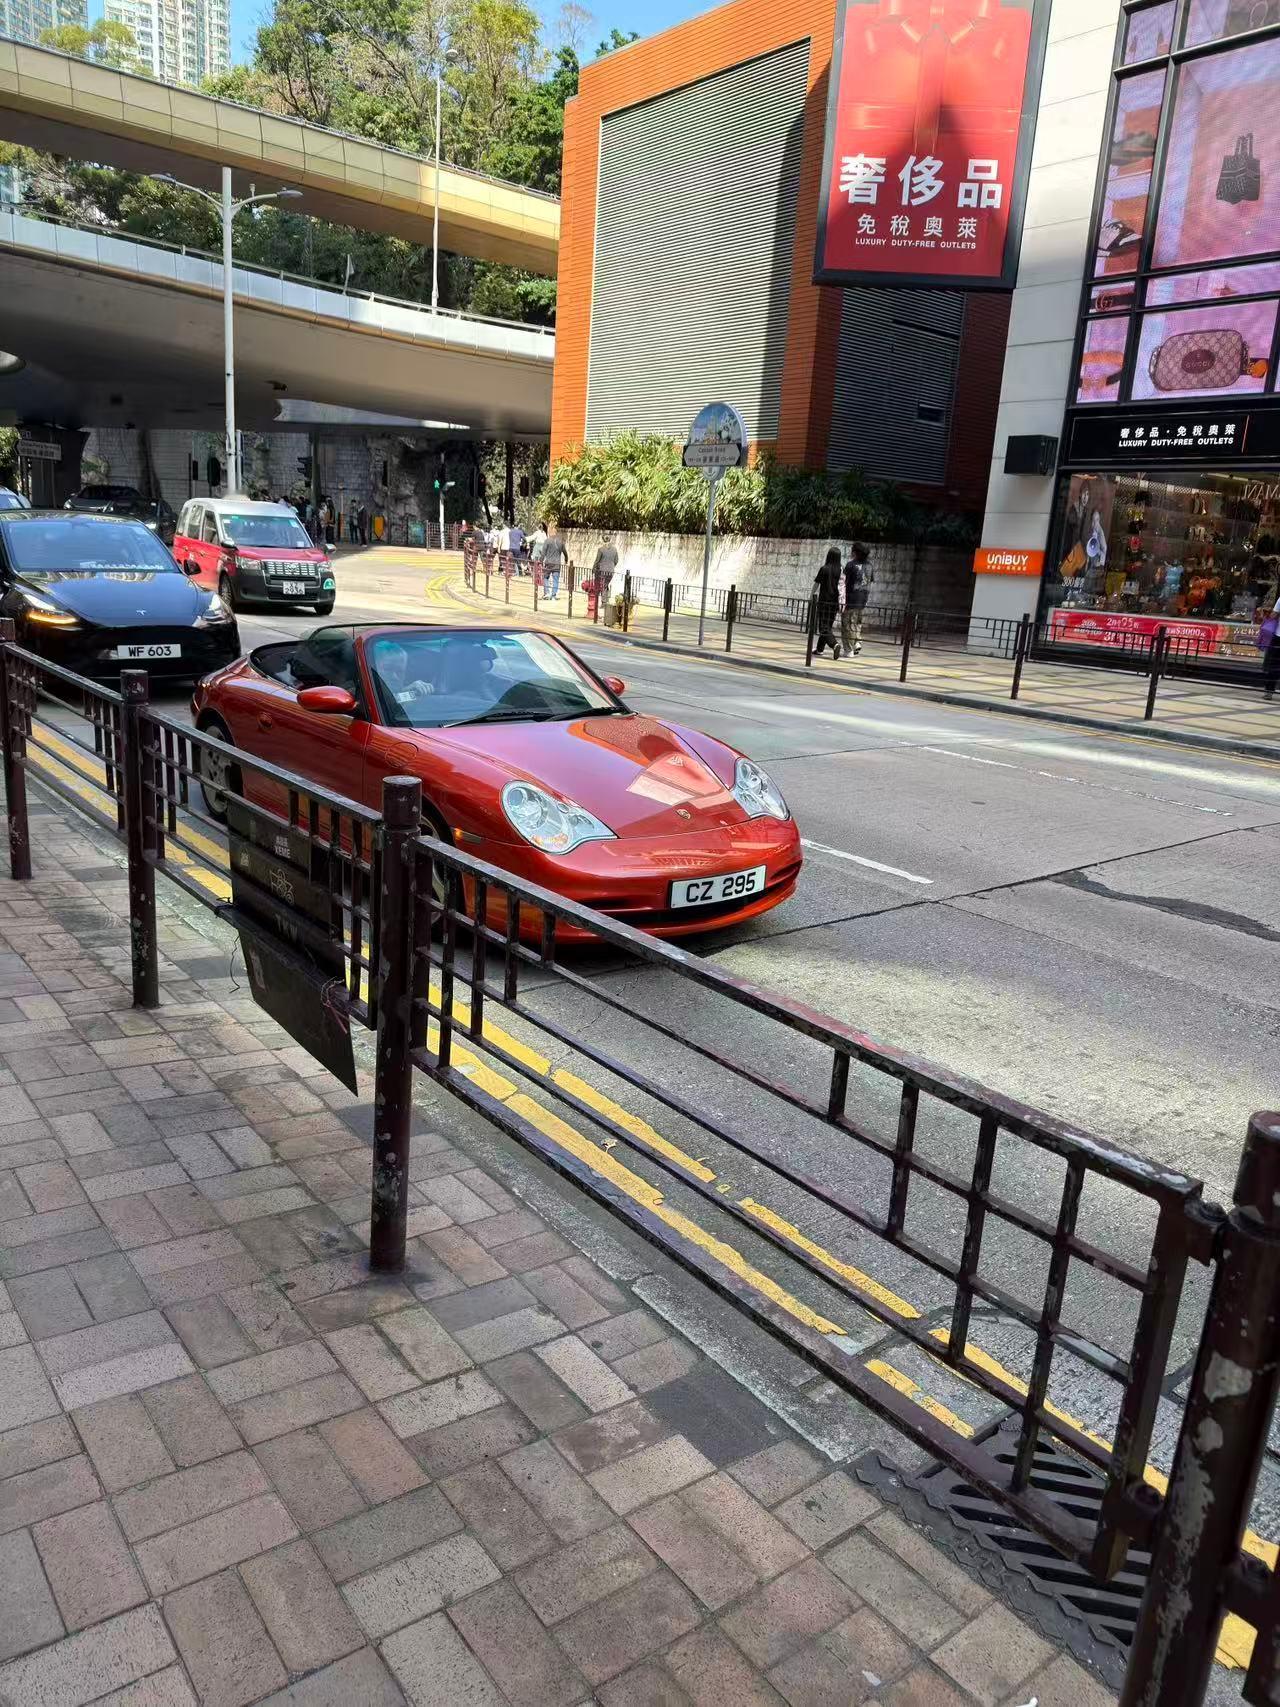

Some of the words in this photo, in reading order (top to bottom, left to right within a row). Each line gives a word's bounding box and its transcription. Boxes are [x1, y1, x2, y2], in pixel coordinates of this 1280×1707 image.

[839, 153, 1003, 209] 奢侈品
[855, 238, 887, 246] LUXURY
[891, 239, 936, 248] DUTY-FREE
[940, 241, 977, 250] OUTLETS
[1151, 438, 1193, 446] DUTY-FREE
[1197, 437, 1235, 445] OUTLETS
[128, 646, 144, 657] WF
[148, 645, 172, 657] 603
[686, 880, 714, 903] CZ
[722, 872, 757, 898] 295
